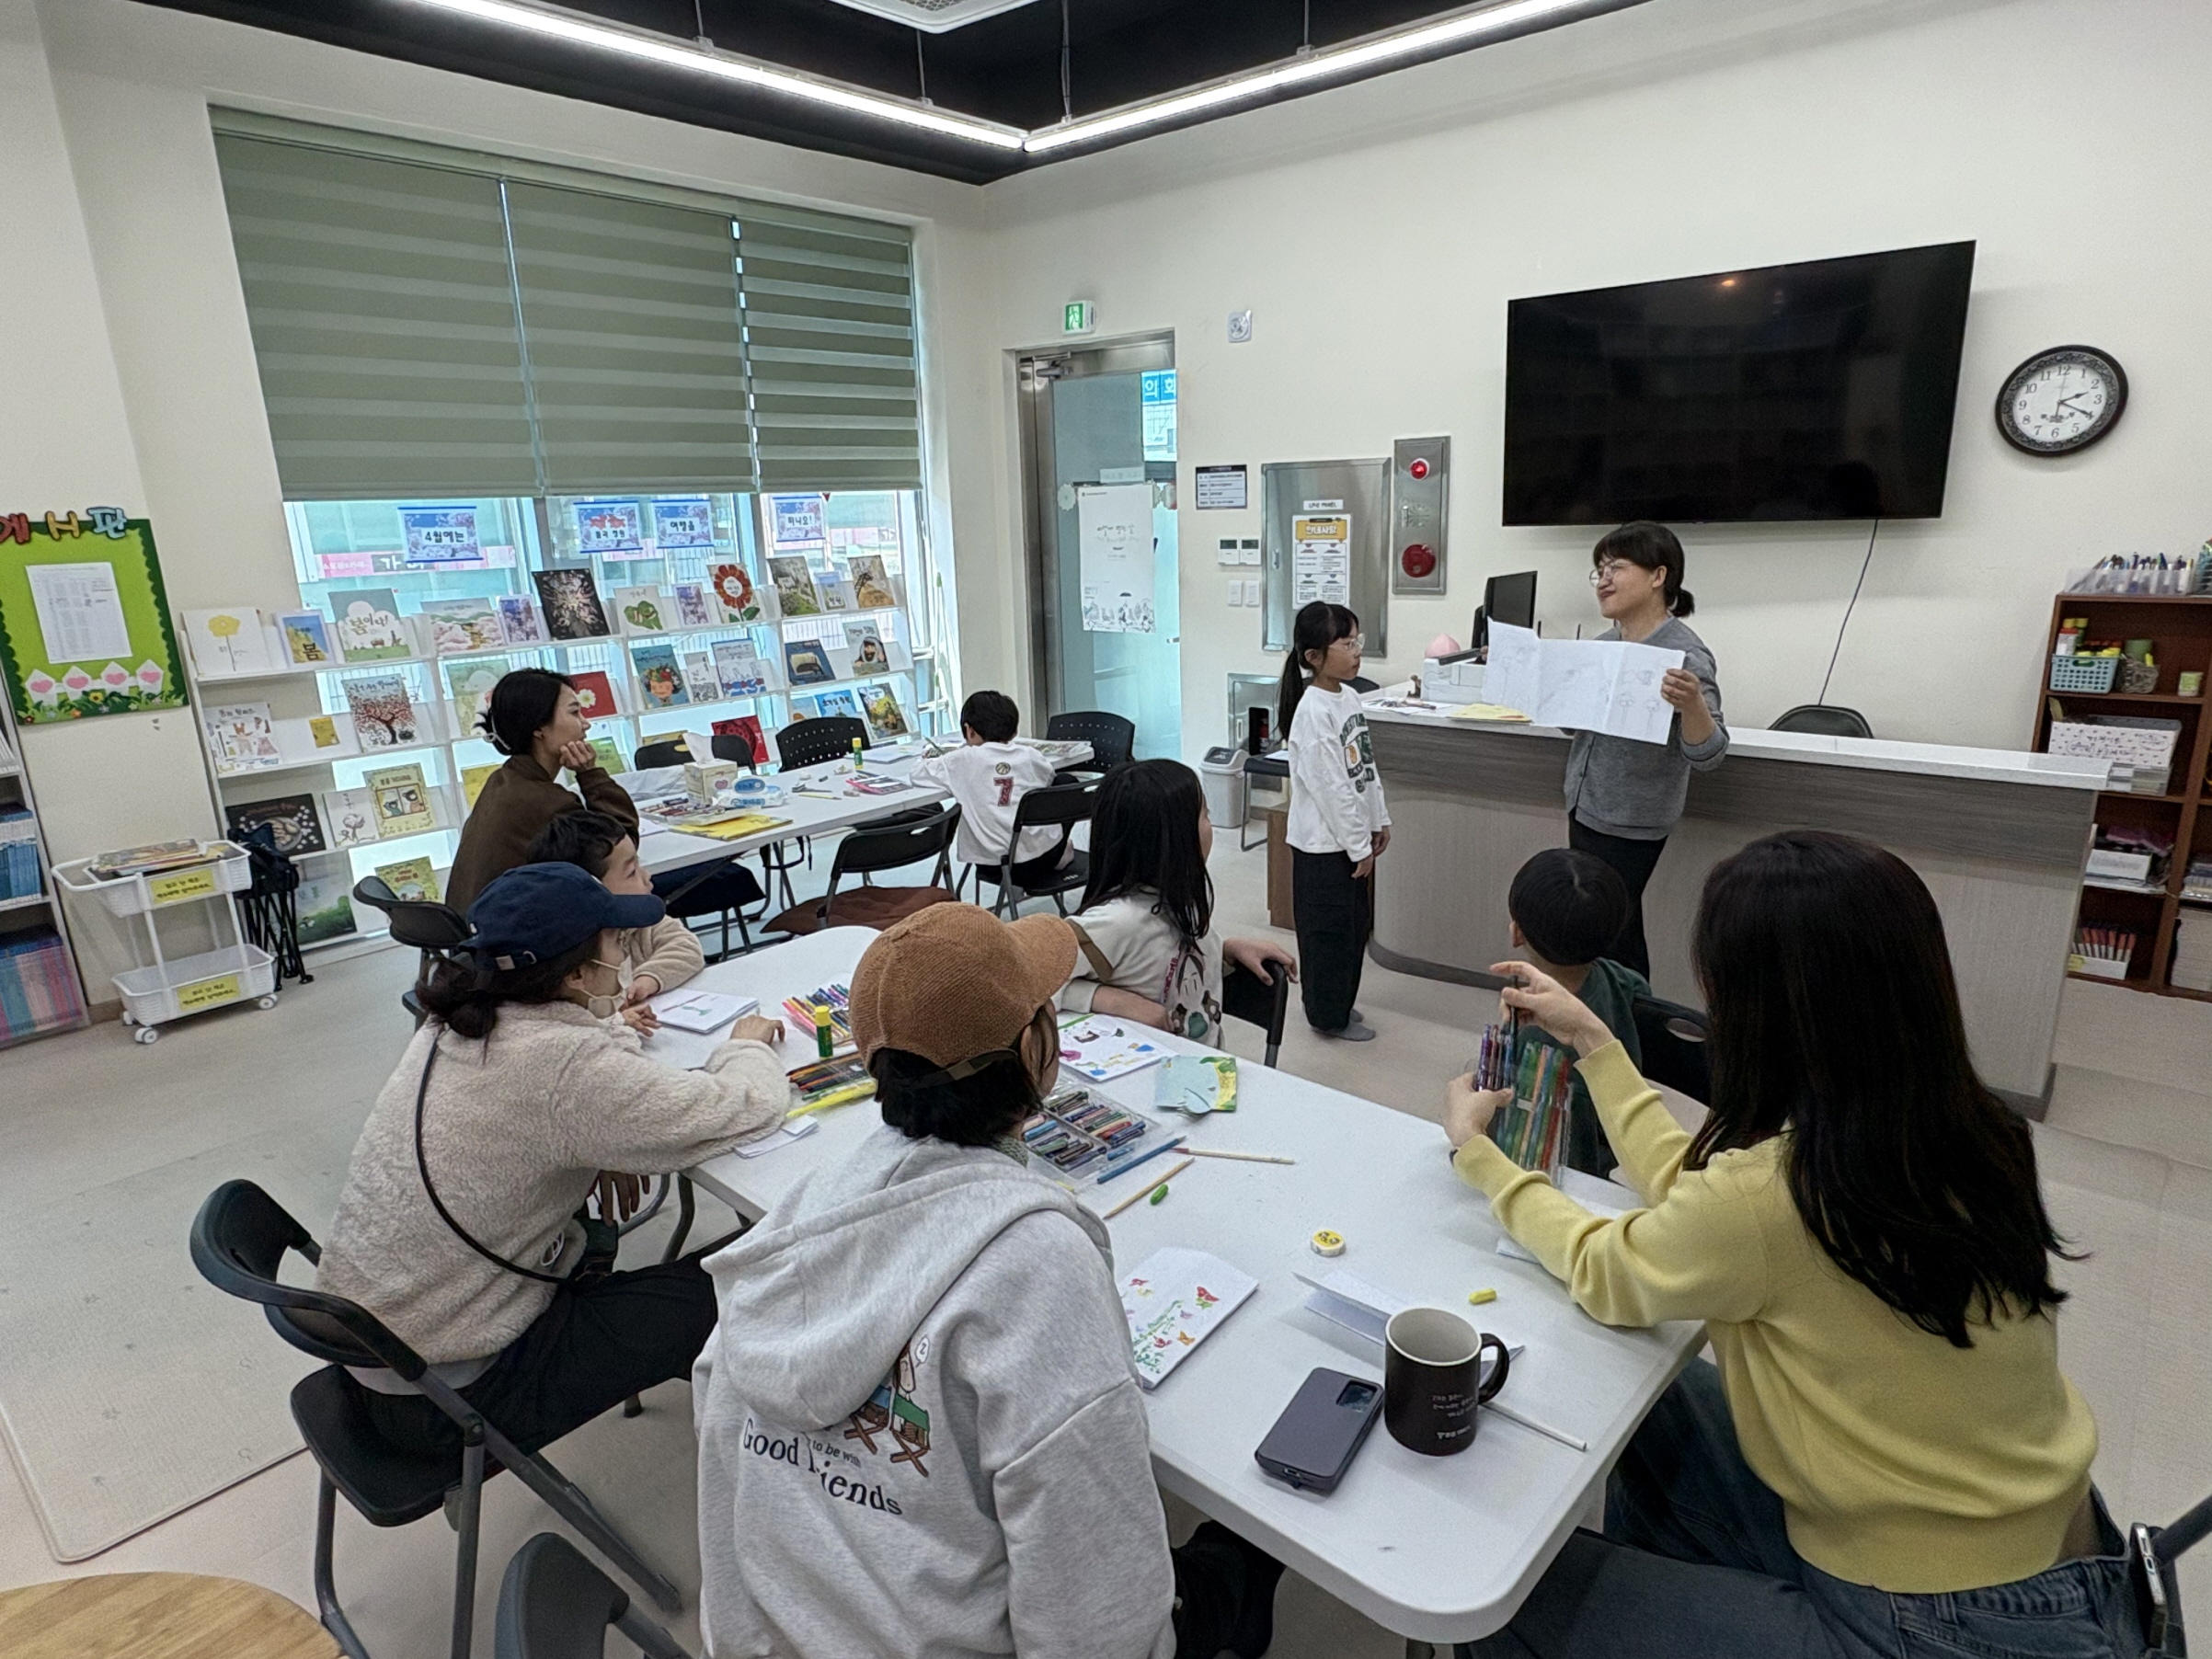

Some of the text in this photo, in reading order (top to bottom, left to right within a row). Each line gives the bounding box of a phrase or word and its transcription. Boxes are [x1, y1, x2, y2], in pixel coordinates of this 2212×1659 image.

[2040, 371, 2051, 381] 11
[2057, 365, 2072, 376] 12
[2080, 368, 2086, 379] 1
[2024, 383, 2037, 394] 10
[2091, 379, 2100, 389] 2
[2019, 400, 2027, 410] 9
[2093, 395, 2102, 405] 3
[2022, 415, 2031, 424] 8
[2034, 425, 2042, 435] 7
[2051, 428, 2059, 438] 6
[2071, 423, 2080, 433] 5
[1305, 524, 1337, 535] 안내사항
[424, 531, 465, 543] 4월에는
[350, 612, 389, 636] 봄이다!
[303, 642, 321, 661] 봄
[993, 776, 1014, 807] 7
[742, 1417, 799, 1467] Good
[811, 1438, 823, 1451] to
[827, 1442, 841, 1459] be
